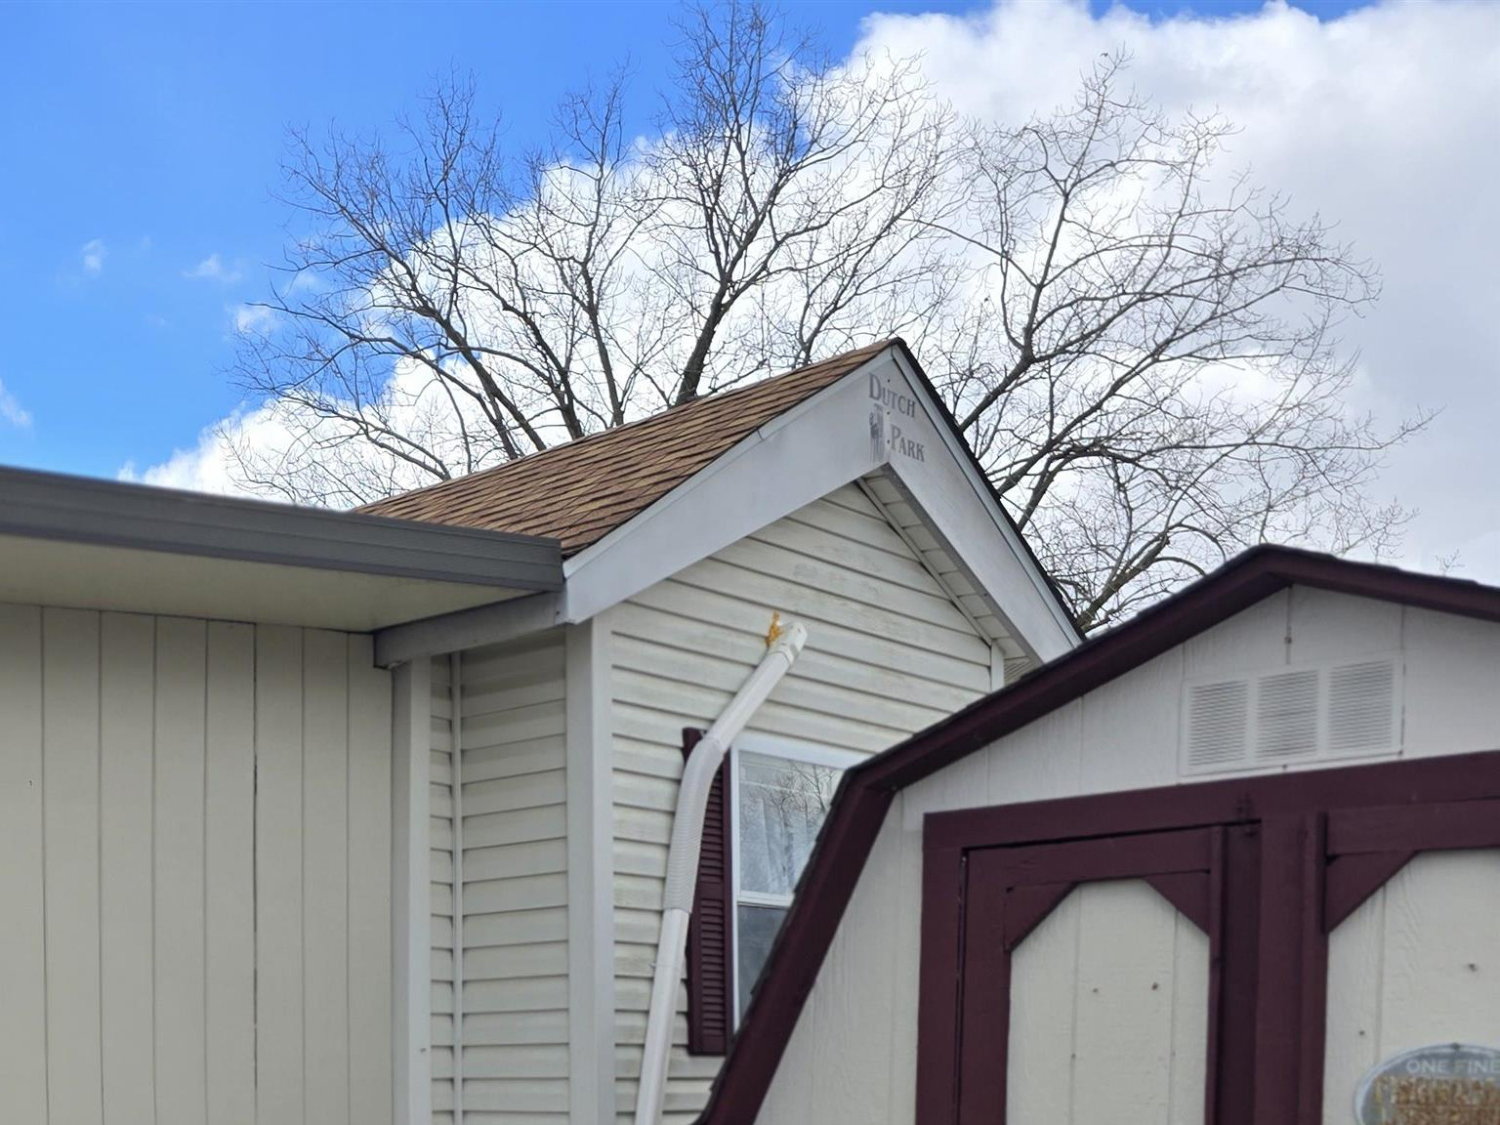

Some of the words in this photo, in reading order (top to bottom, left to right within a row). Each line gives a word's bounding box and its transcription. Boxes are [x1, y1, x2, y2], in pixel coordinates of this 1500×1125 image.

[869, 373, 916, 418] DUTCH
[891, 424, 924, 462] PARK
[1406, 1060, 1448, 1073] ONE
[1455, 1060, 1500, 1073] FINE
